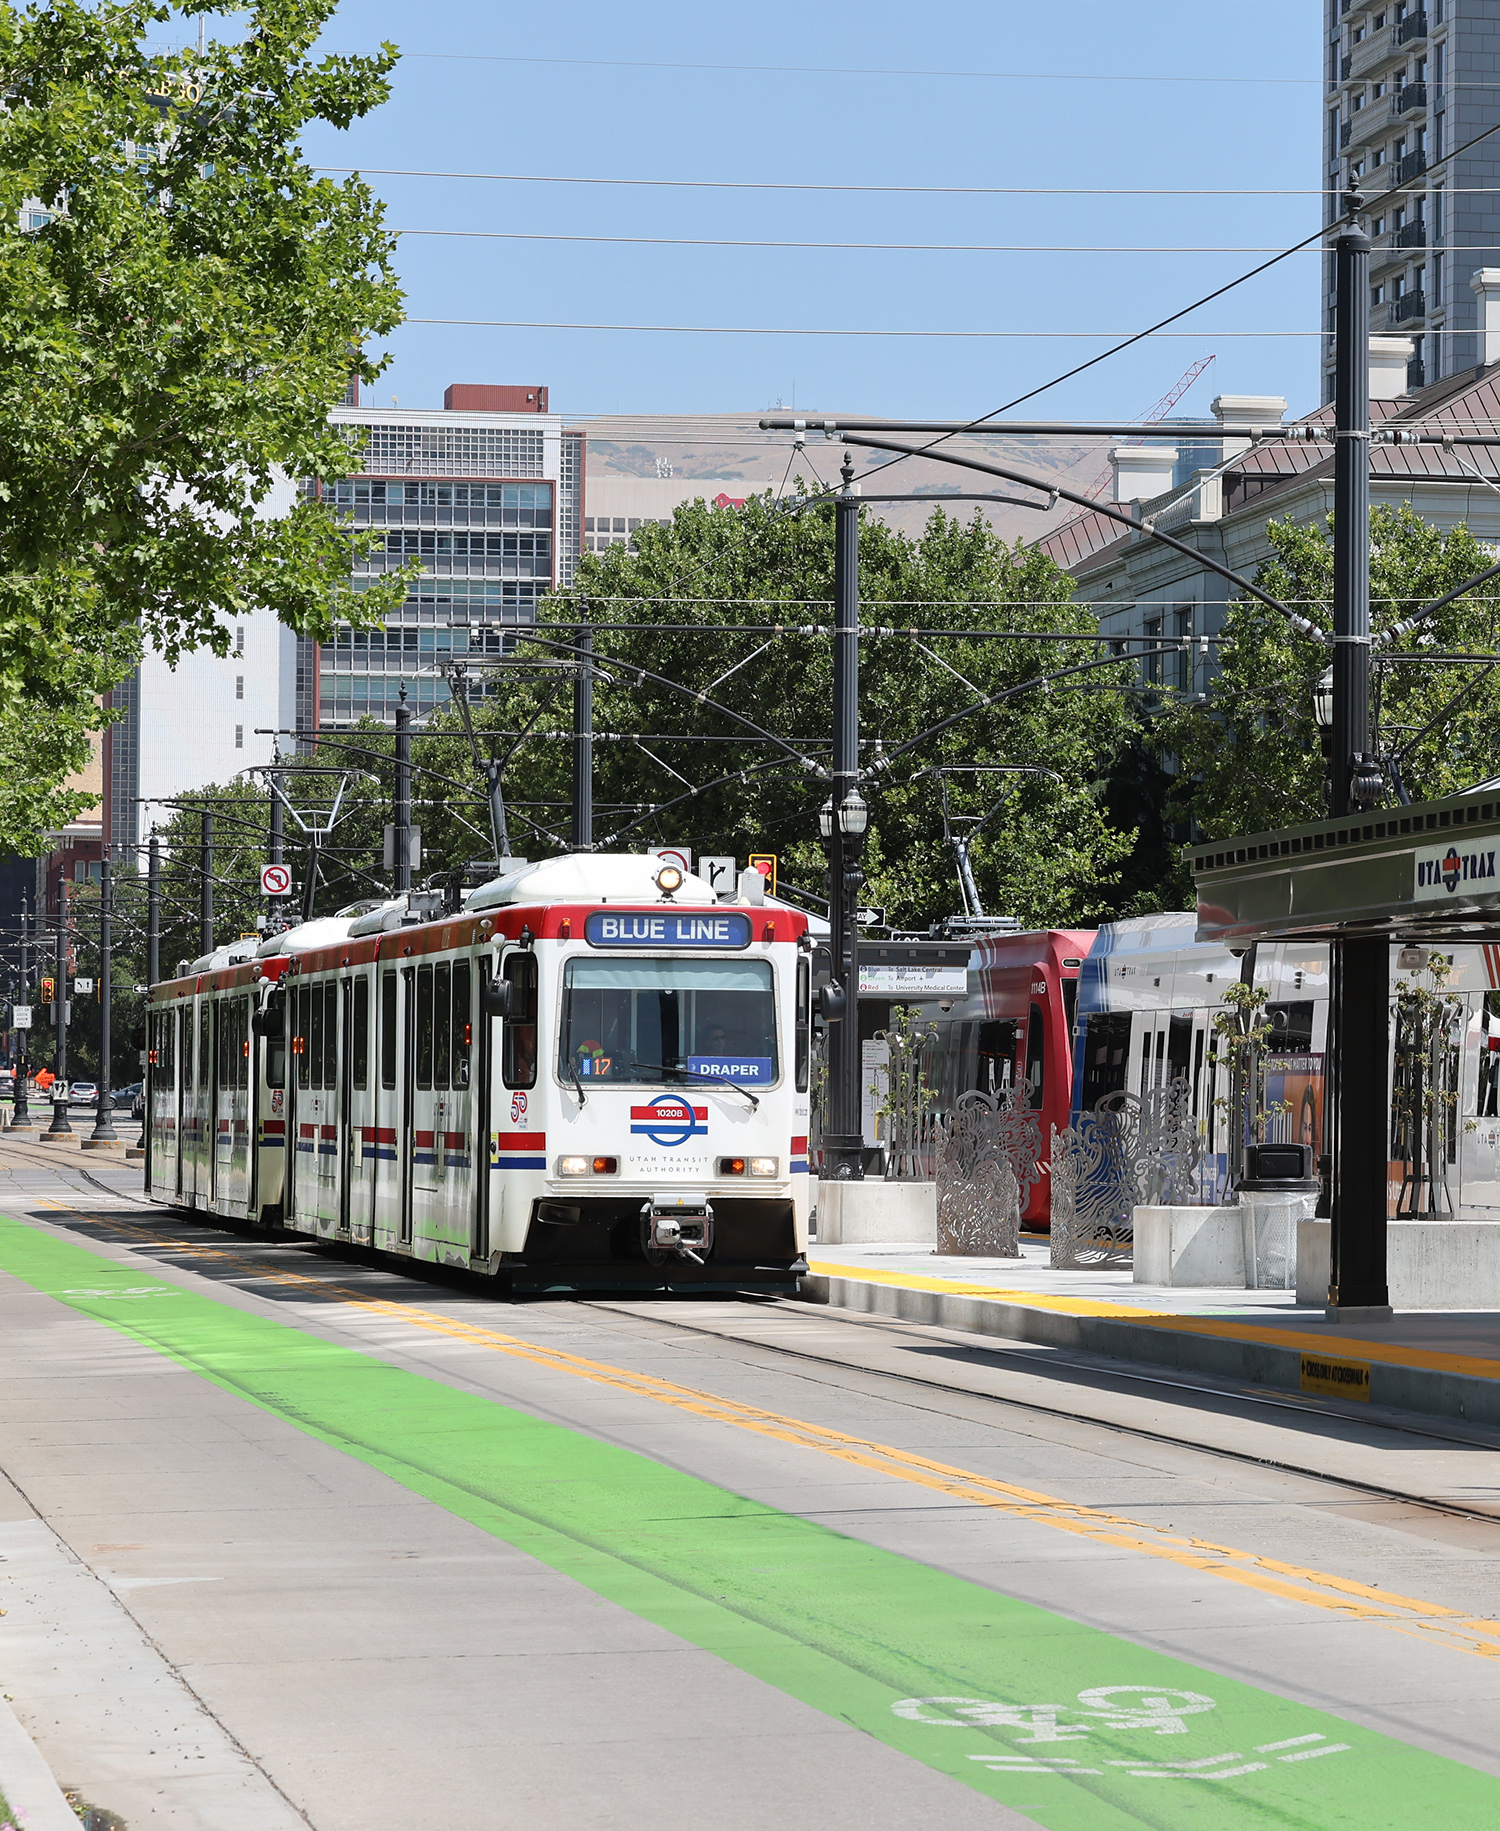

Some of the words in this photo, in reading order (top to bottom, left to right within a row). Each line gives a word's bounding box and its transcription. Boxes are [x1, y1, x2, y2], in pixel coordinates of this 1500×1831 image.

[1416, 861, 1442, 888] UTA
[1462, 850, 1496, 882] TRAX
[601, 917, 665, 940] BLUE
[677, 919, 730, 940] LINE
[1031, 981, 1046, 995] 1114B
[594, 1058, 612, 1075] 17
[700, 1064, 759, 1076] DRAPER
[656, 1109, 683, 1117] 1020B
[1306, 1360, 1320, 1379] CROSS
[1320, 1363, 1331, 1380] ONLY
[1337, 1366, 1363, 1385] CROSSWALK
